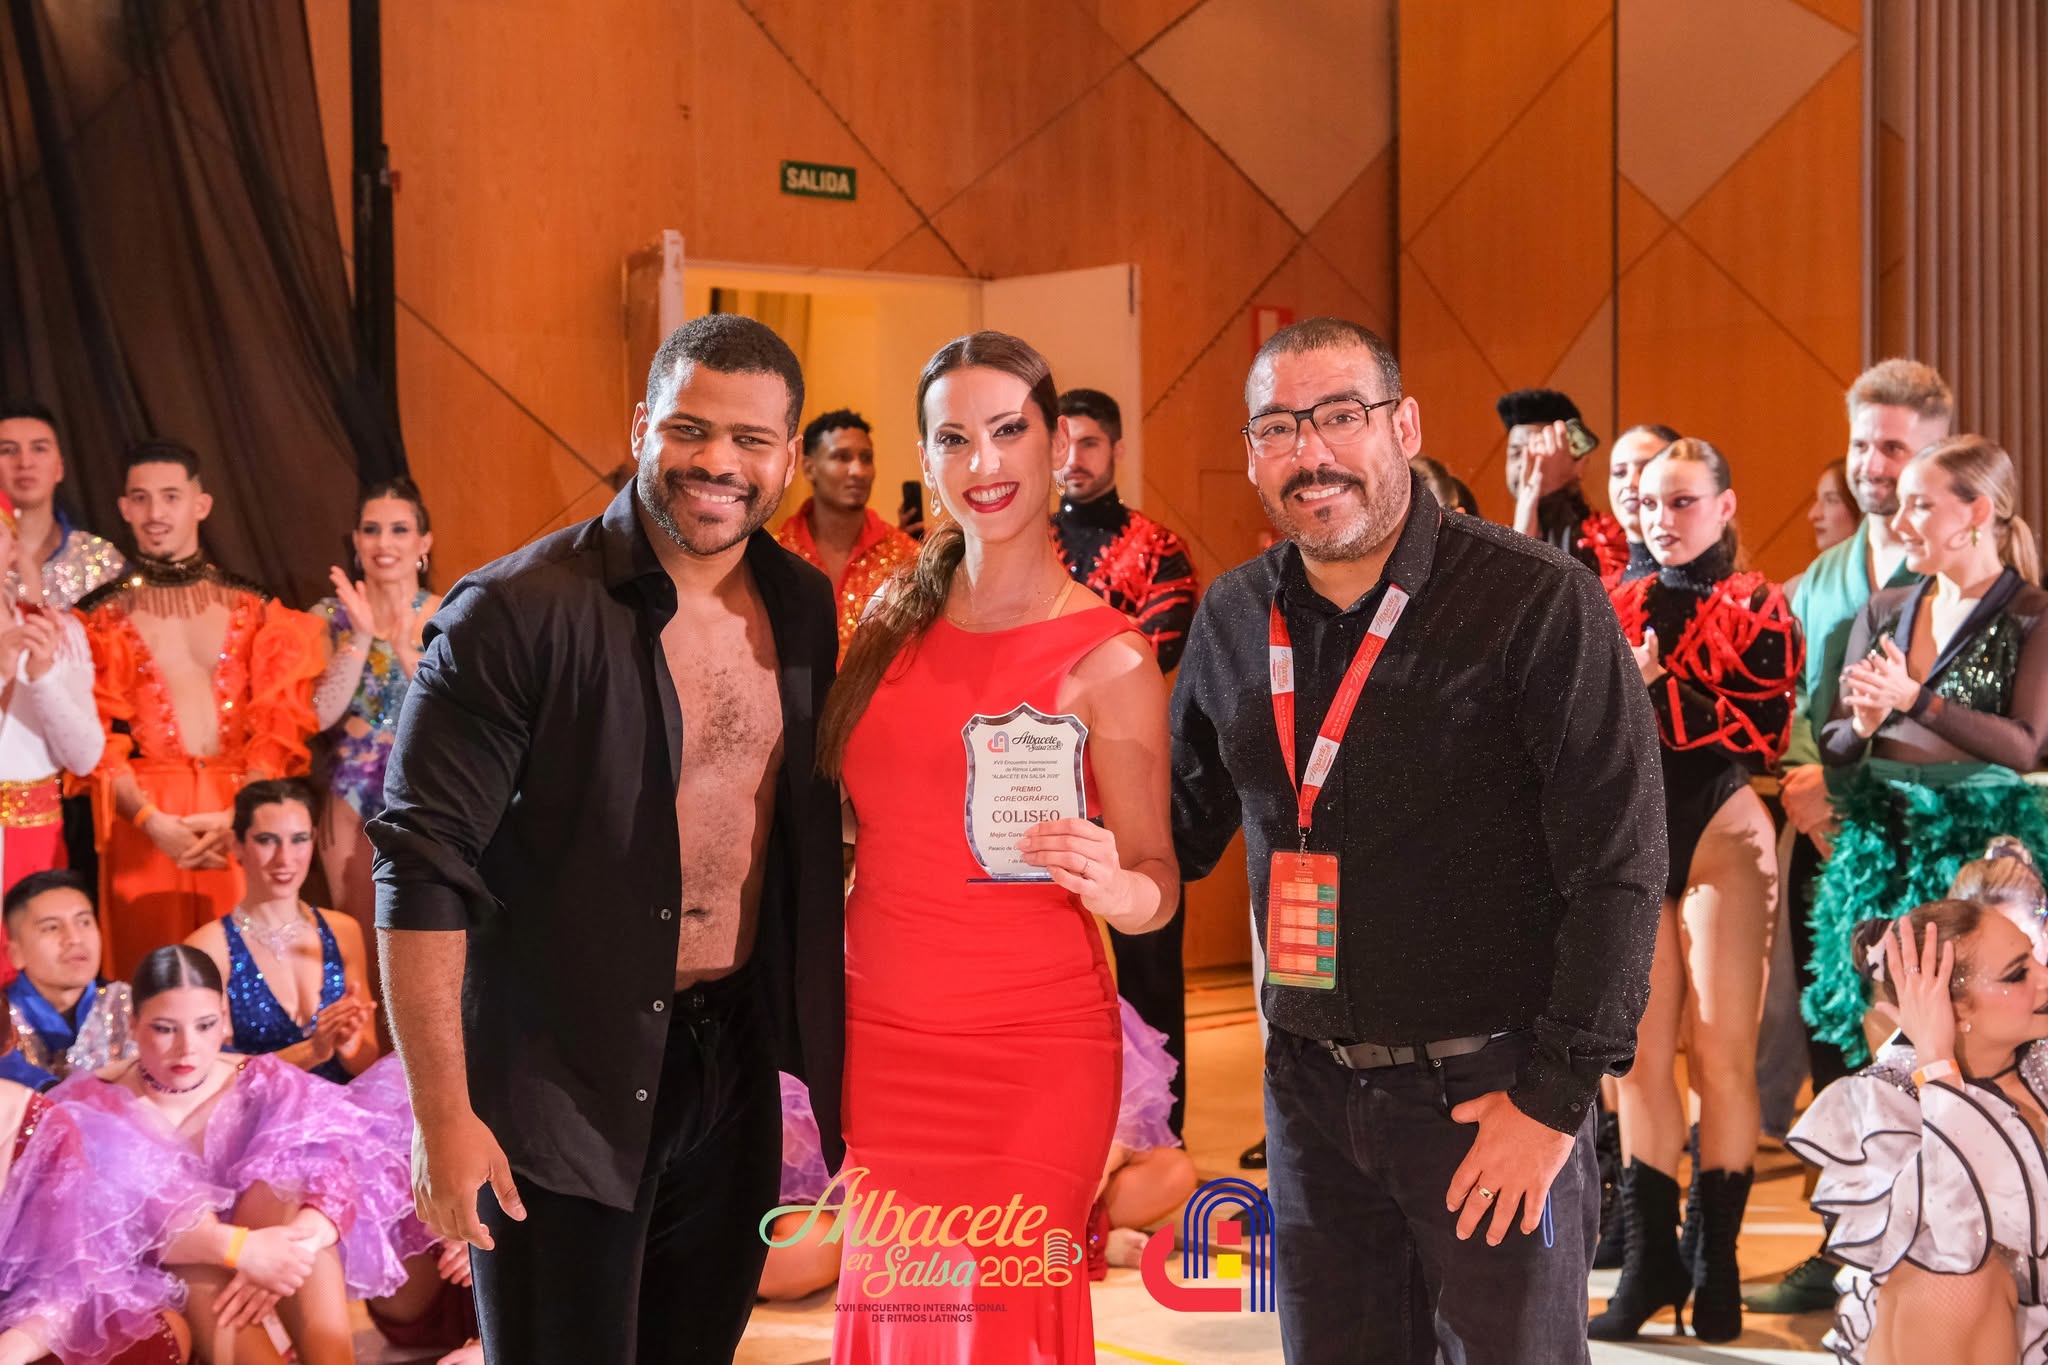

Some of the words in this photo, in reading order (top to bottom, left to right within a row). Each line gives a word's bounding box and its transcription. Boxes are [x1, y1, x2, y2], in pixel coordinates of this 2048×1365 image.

[786, 167, 851, 195] SALIDA
[1011, 730, 1058, 745] Albacete
[1010, 785, 1042, 793] PREMIO
[991, 809, 1061, 823] COLISEO
